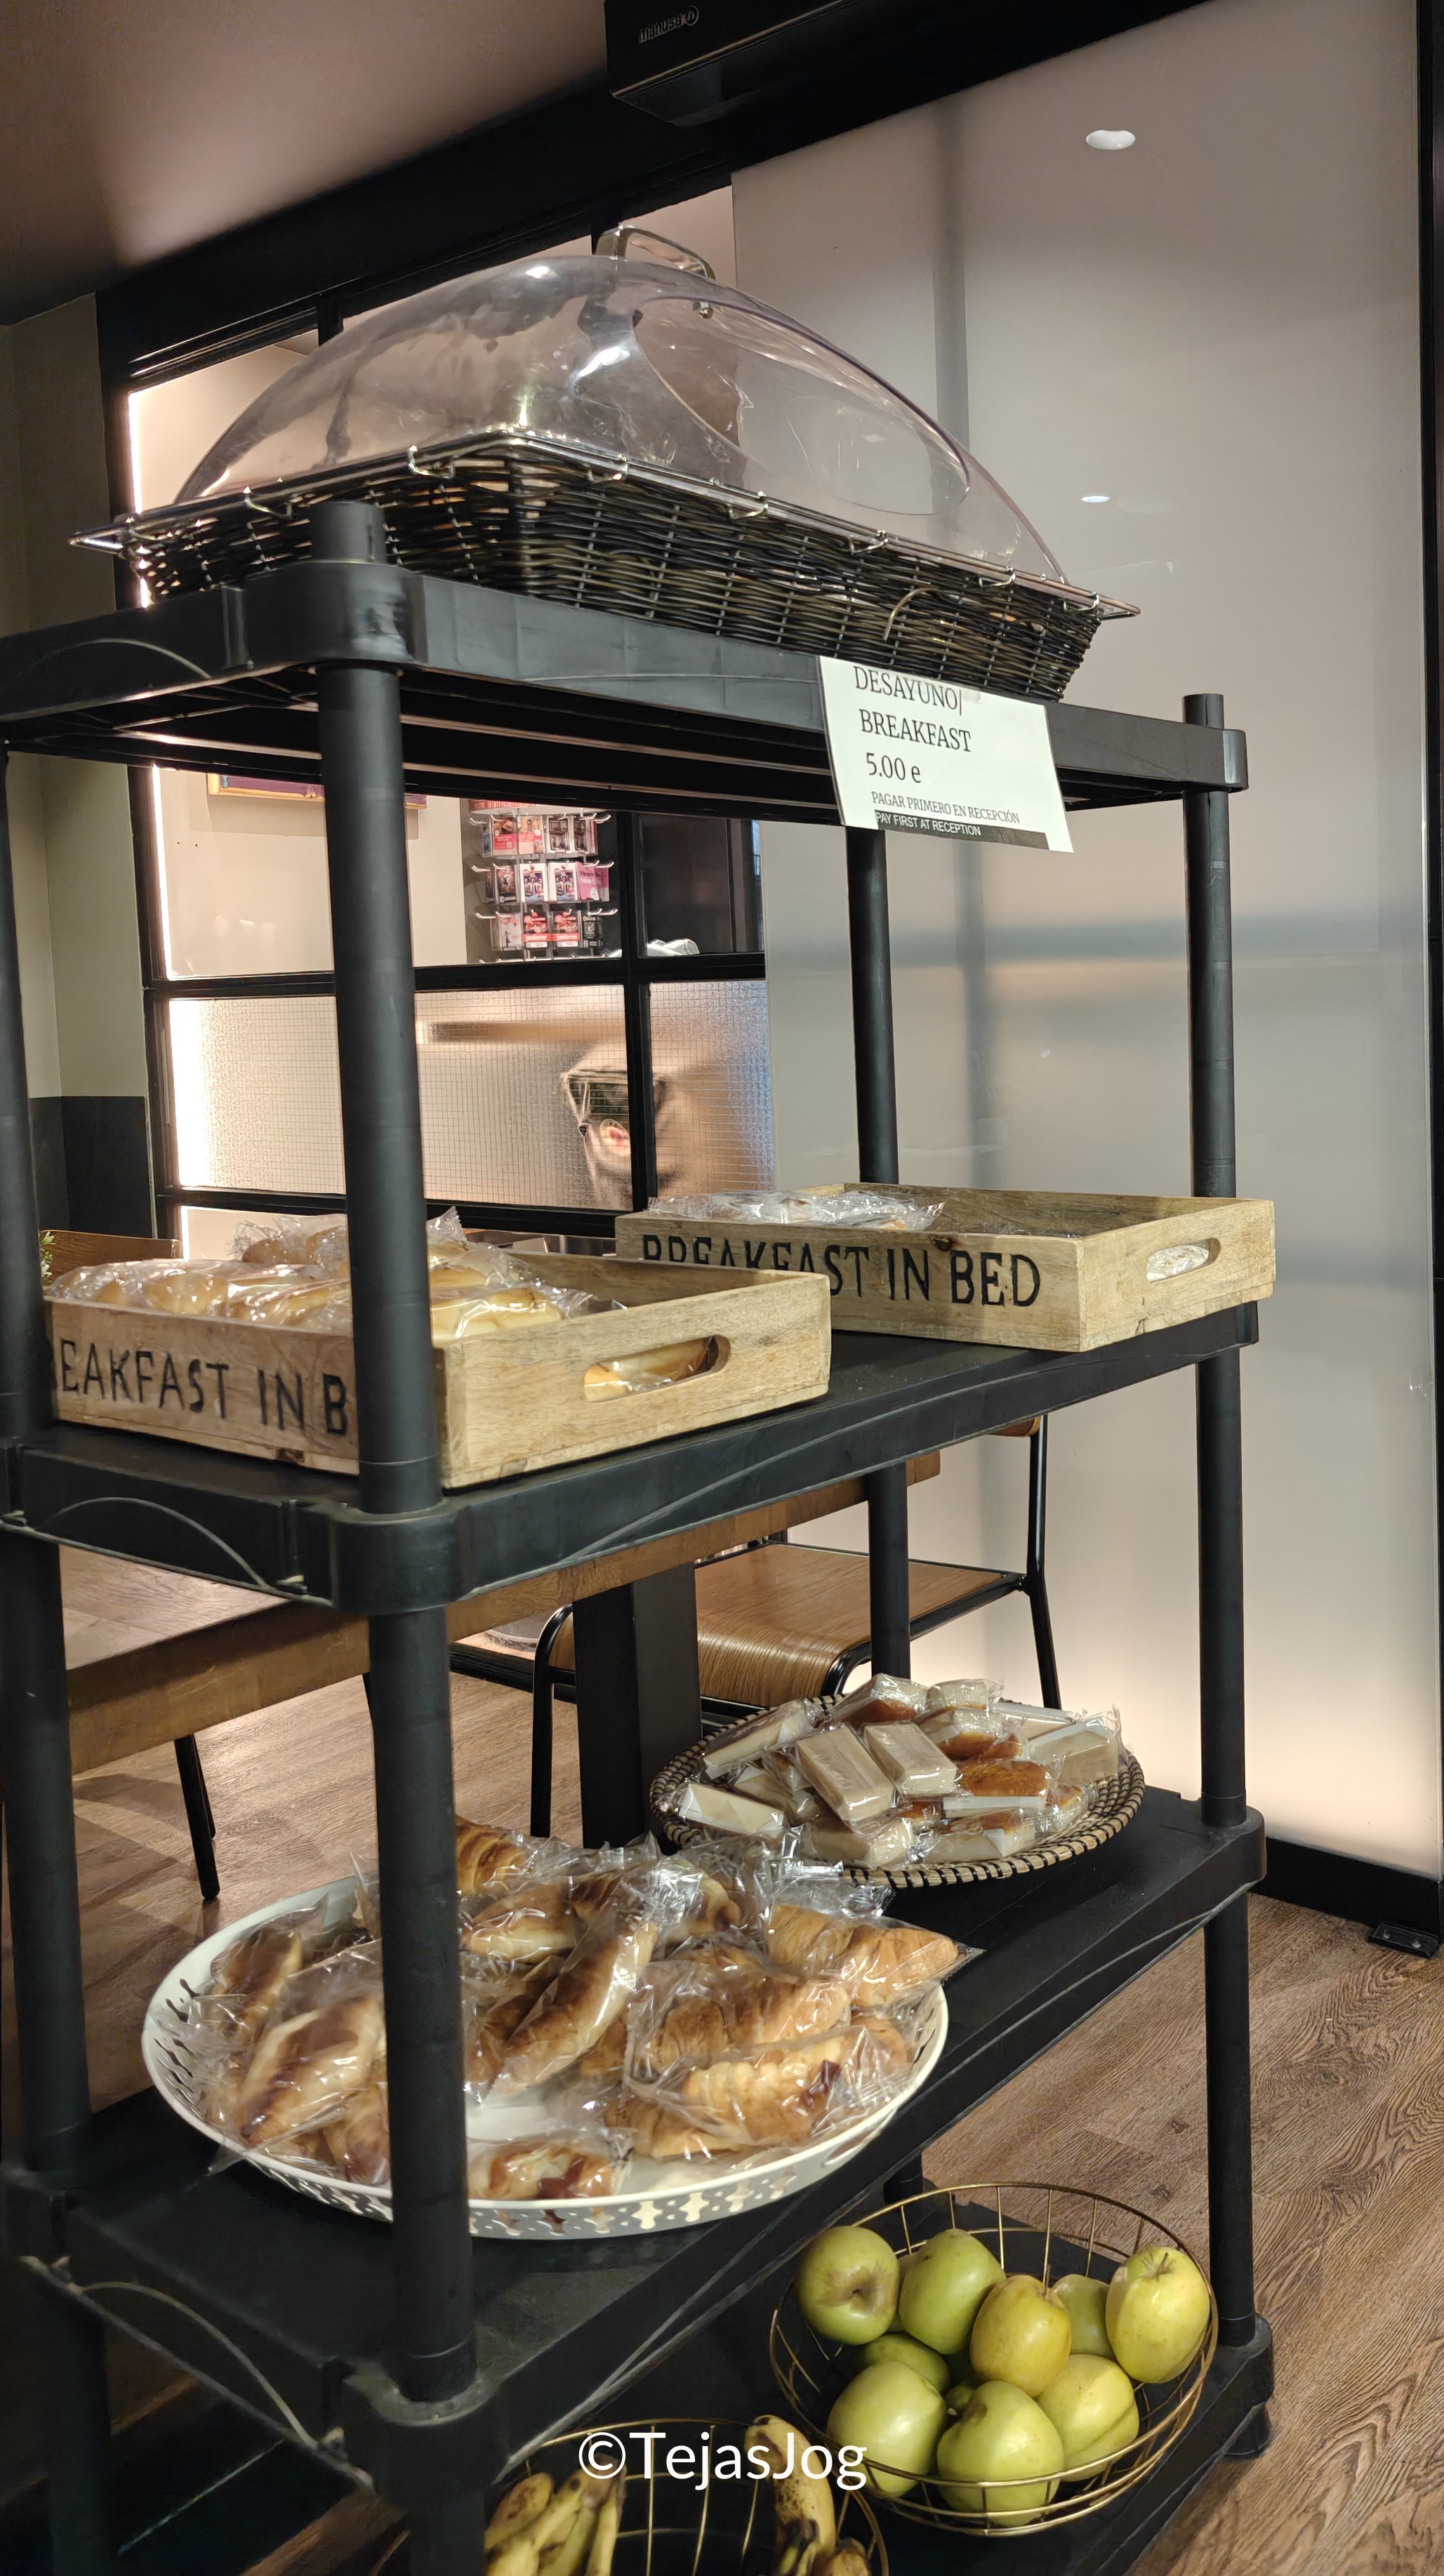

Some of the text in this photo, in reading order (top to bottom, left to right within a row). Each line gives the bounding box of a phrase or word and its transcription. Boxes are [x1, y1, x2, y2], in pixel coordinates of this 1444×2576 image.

[859, 708, 972, 752] BREAKFAST
[866, 752, 922, 783] 5.00 e
[871, 791, 1021, 824] PAGAR PRIMERO EN RECEPCIÓN
[875, 811, 982, 836] PAY FIRST AT RECEPTION
[887, 1248, 930, 1301] IN
[949, 1250, 1040, 1307] BED
[60, 1339, 348, 1436] EAKFAST IN B
